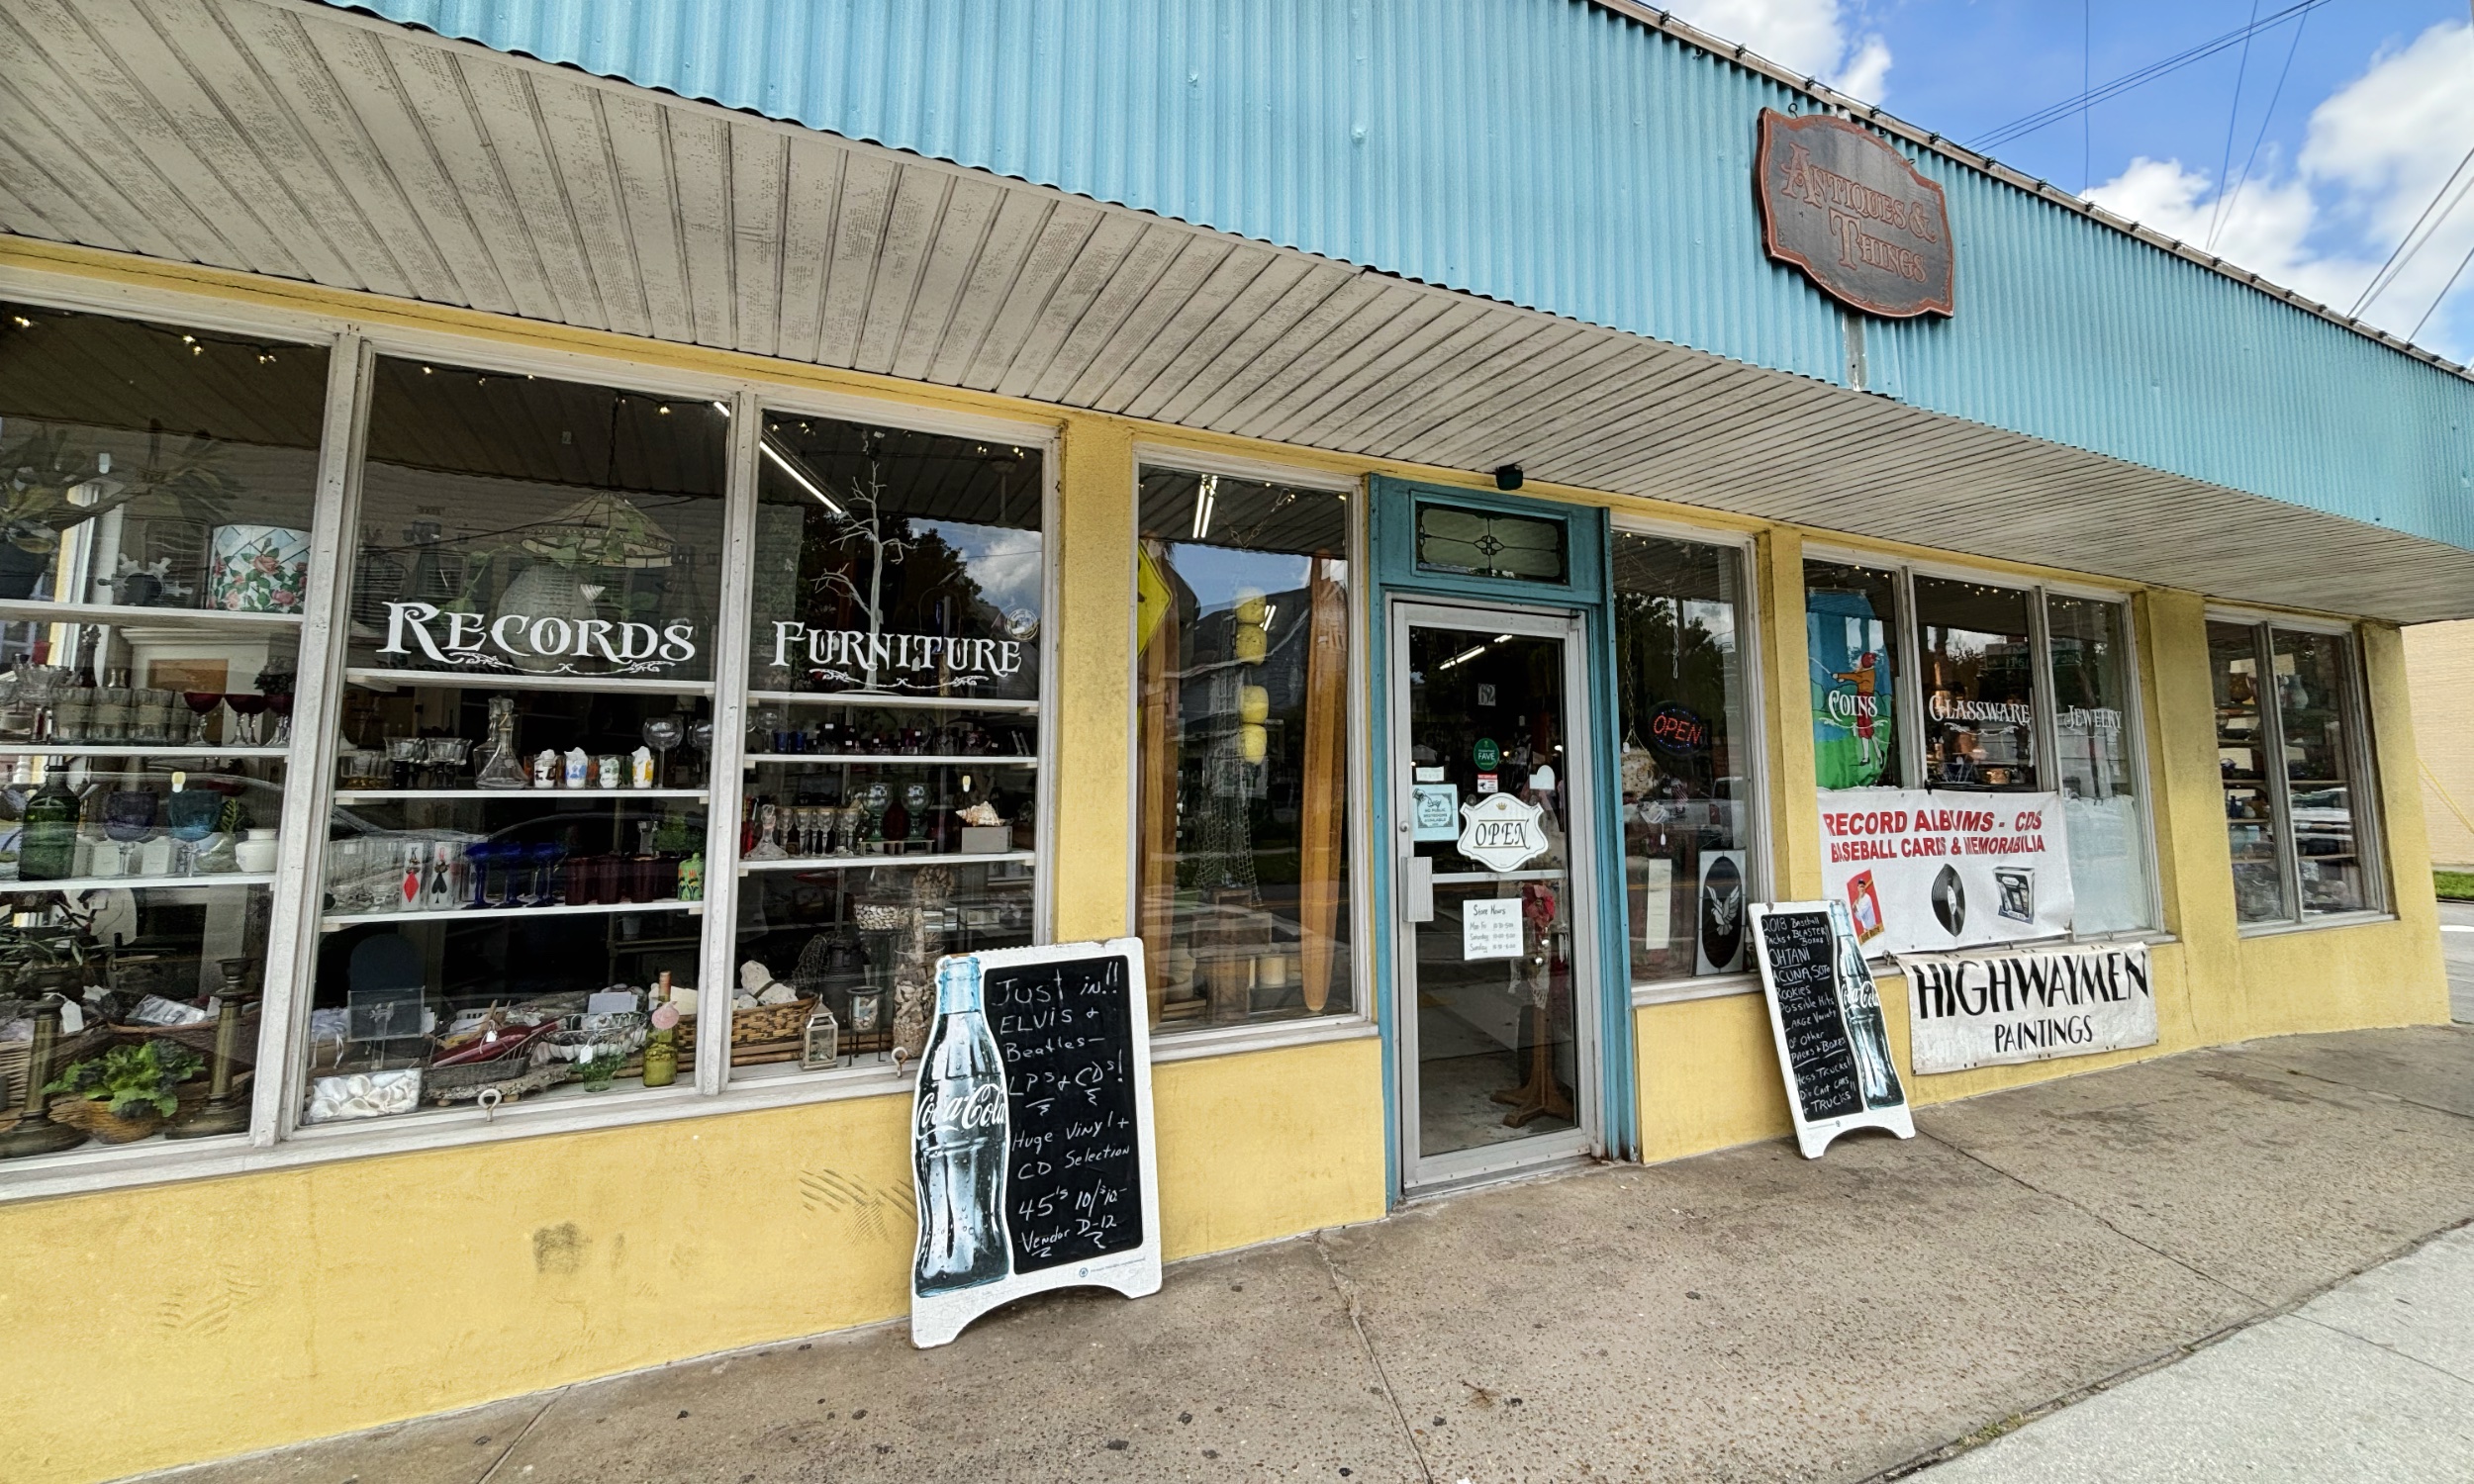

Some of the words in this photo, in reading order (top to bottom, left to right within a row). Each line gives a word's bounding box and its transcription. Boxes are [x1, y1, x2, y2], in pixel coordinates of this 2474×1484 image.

[1780, 141, 1907, 231] ANTIQUES
[1909, 201, 1937, 244] &
[1829, 206, 1927, 284] THINGS
[375, 599, 697, 666] RECORDS
[769, 620, 1022, 678] FURNITURE
[1828, 690, 1877, 721] COINS
[1929, 695, 2030, 725] GLASSWARE
[2064, 704, 2122, 730] JEWELRY
[1653, 714, 1702, 745] OPEN
[1478, 752, 1494, 761] FAVE
[1475, 818, 1531, 850] OPEN
[1823, 811, 1908, 837] RECORD
[1914, 809, 1995, 832] ALBUMS
[1831, 839, 1897, 864] BASEBALL
[1951, 837, 1961, 855] &
[1761, 917, 1787, 932] 2018
[1767, 947, 1811, 968] OHTANI
[1911, 951, 2148, 1020] HIGHWAYMEN
[1994, 1015, 2093, 1054] PAINTINGS
[1011, 1129, 1054, 1155] Huge
[1017, 1161, 1052, 1179] CD
[1064, 1144, 1130, 1168] Selection
[1018, 1185, 1069, 1221] 45's
[1021, 1225, 1071, 1252] Vendor
